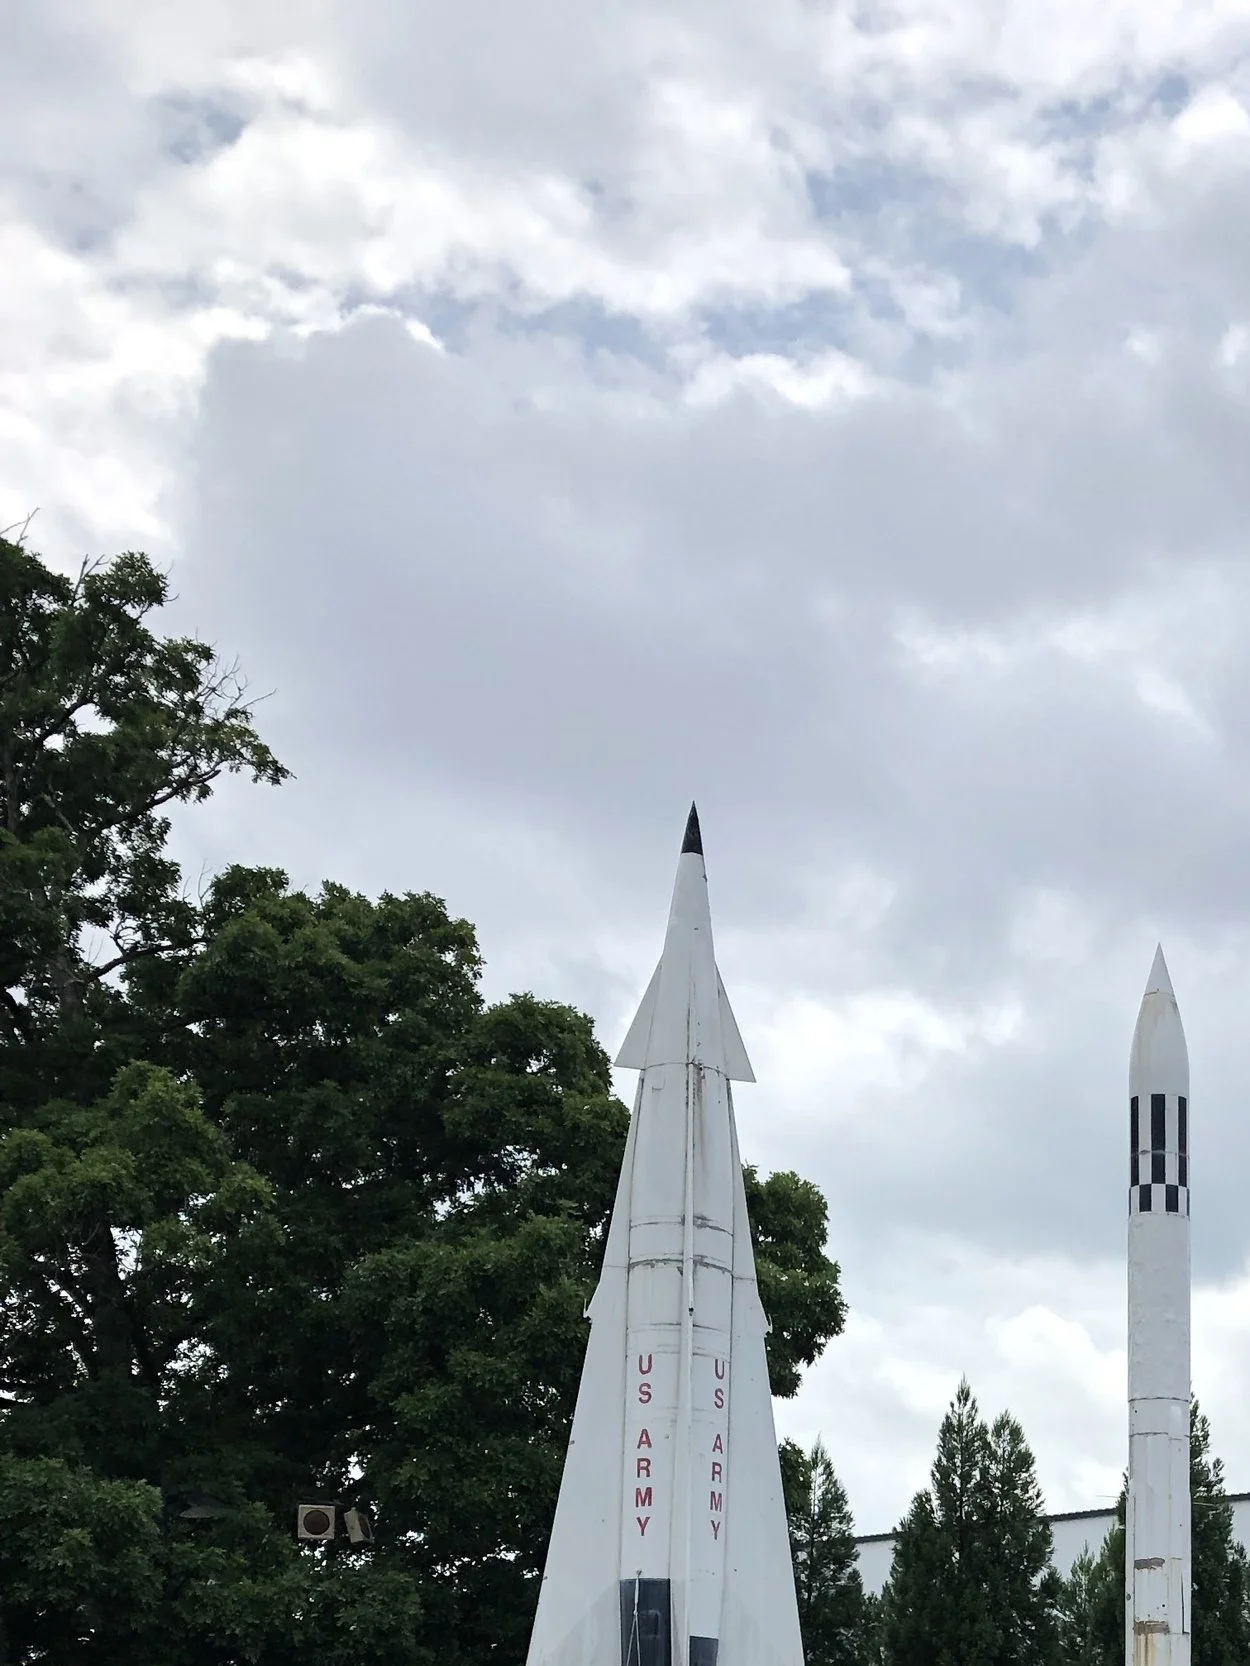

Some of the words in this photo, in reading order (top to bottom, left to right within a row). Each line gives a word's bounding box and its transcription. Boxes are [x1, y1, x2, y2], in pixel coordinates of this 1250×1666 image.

[638, 1354, 653, 1404] US
[713, 1359, 725, 1409] US
[634, 1428, 653, 1538] ARMY
[709, 1434, 723, 1540] ARMY
